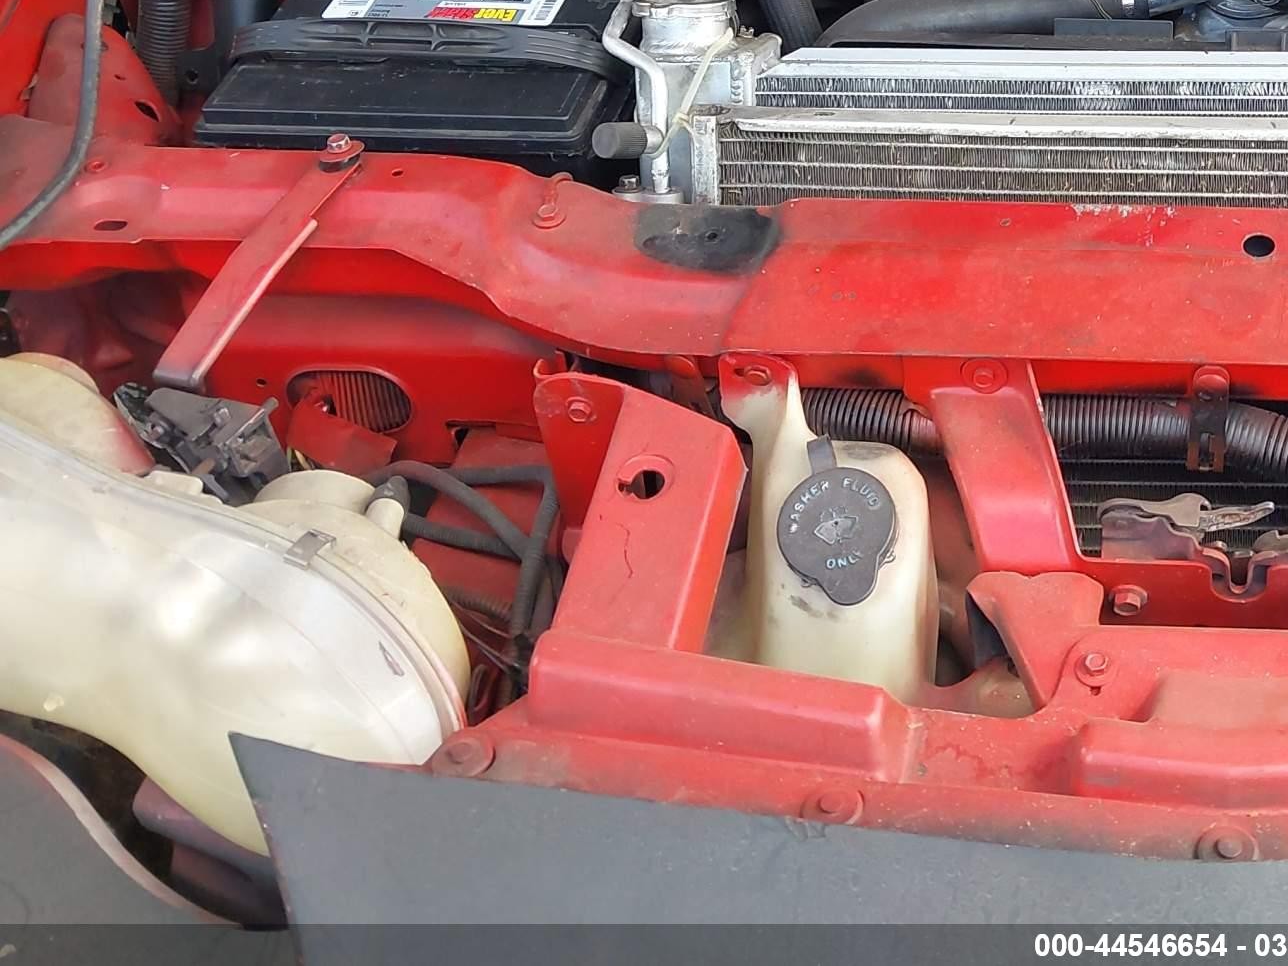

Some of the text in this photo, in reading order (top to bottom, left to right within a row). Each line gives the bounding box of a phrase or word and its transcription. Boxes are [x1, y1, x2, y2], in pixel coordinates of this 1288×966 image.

[789, 477, 882, 534] WASHER FLUID
[826, 549, 864, 569] ONLY
